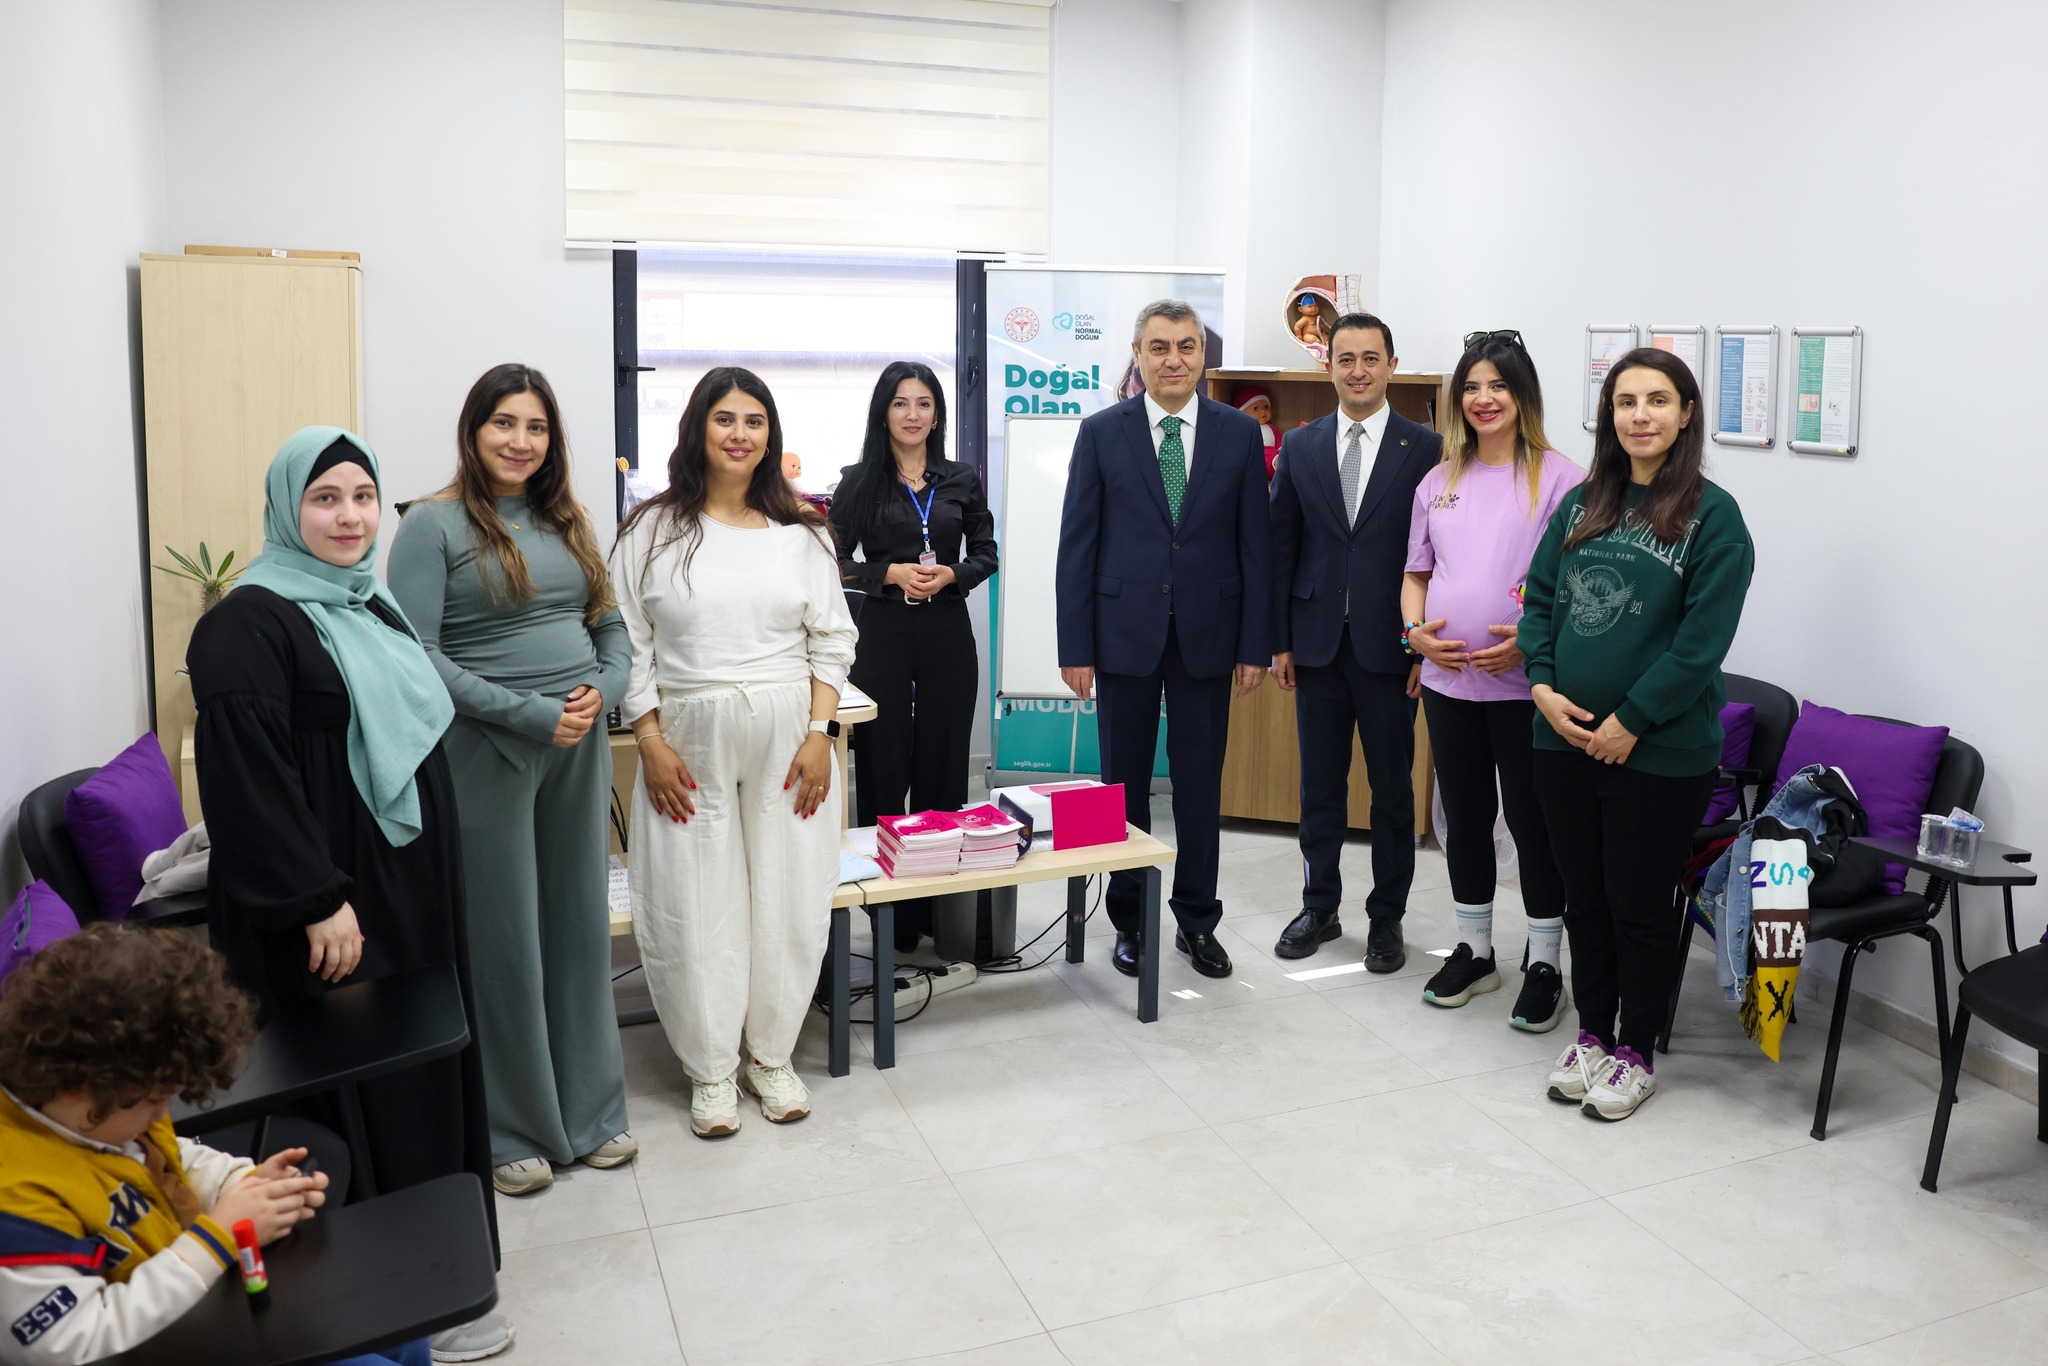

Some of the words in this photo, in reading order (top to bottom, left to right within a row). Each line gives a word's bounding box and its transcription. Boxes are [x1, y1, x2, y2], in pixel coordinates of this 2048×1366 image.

[1004, 364, 1100, 395] Doğal
[1004, 395, 1081, 414] Olan
[1578, 548, 1614, 559] NATIONAL
[1615, 552, 1637, 562] PARK
[1013, 760, 1052, 768] saglik.gov.tr
[14, 1289, 75, 1342] EST.
